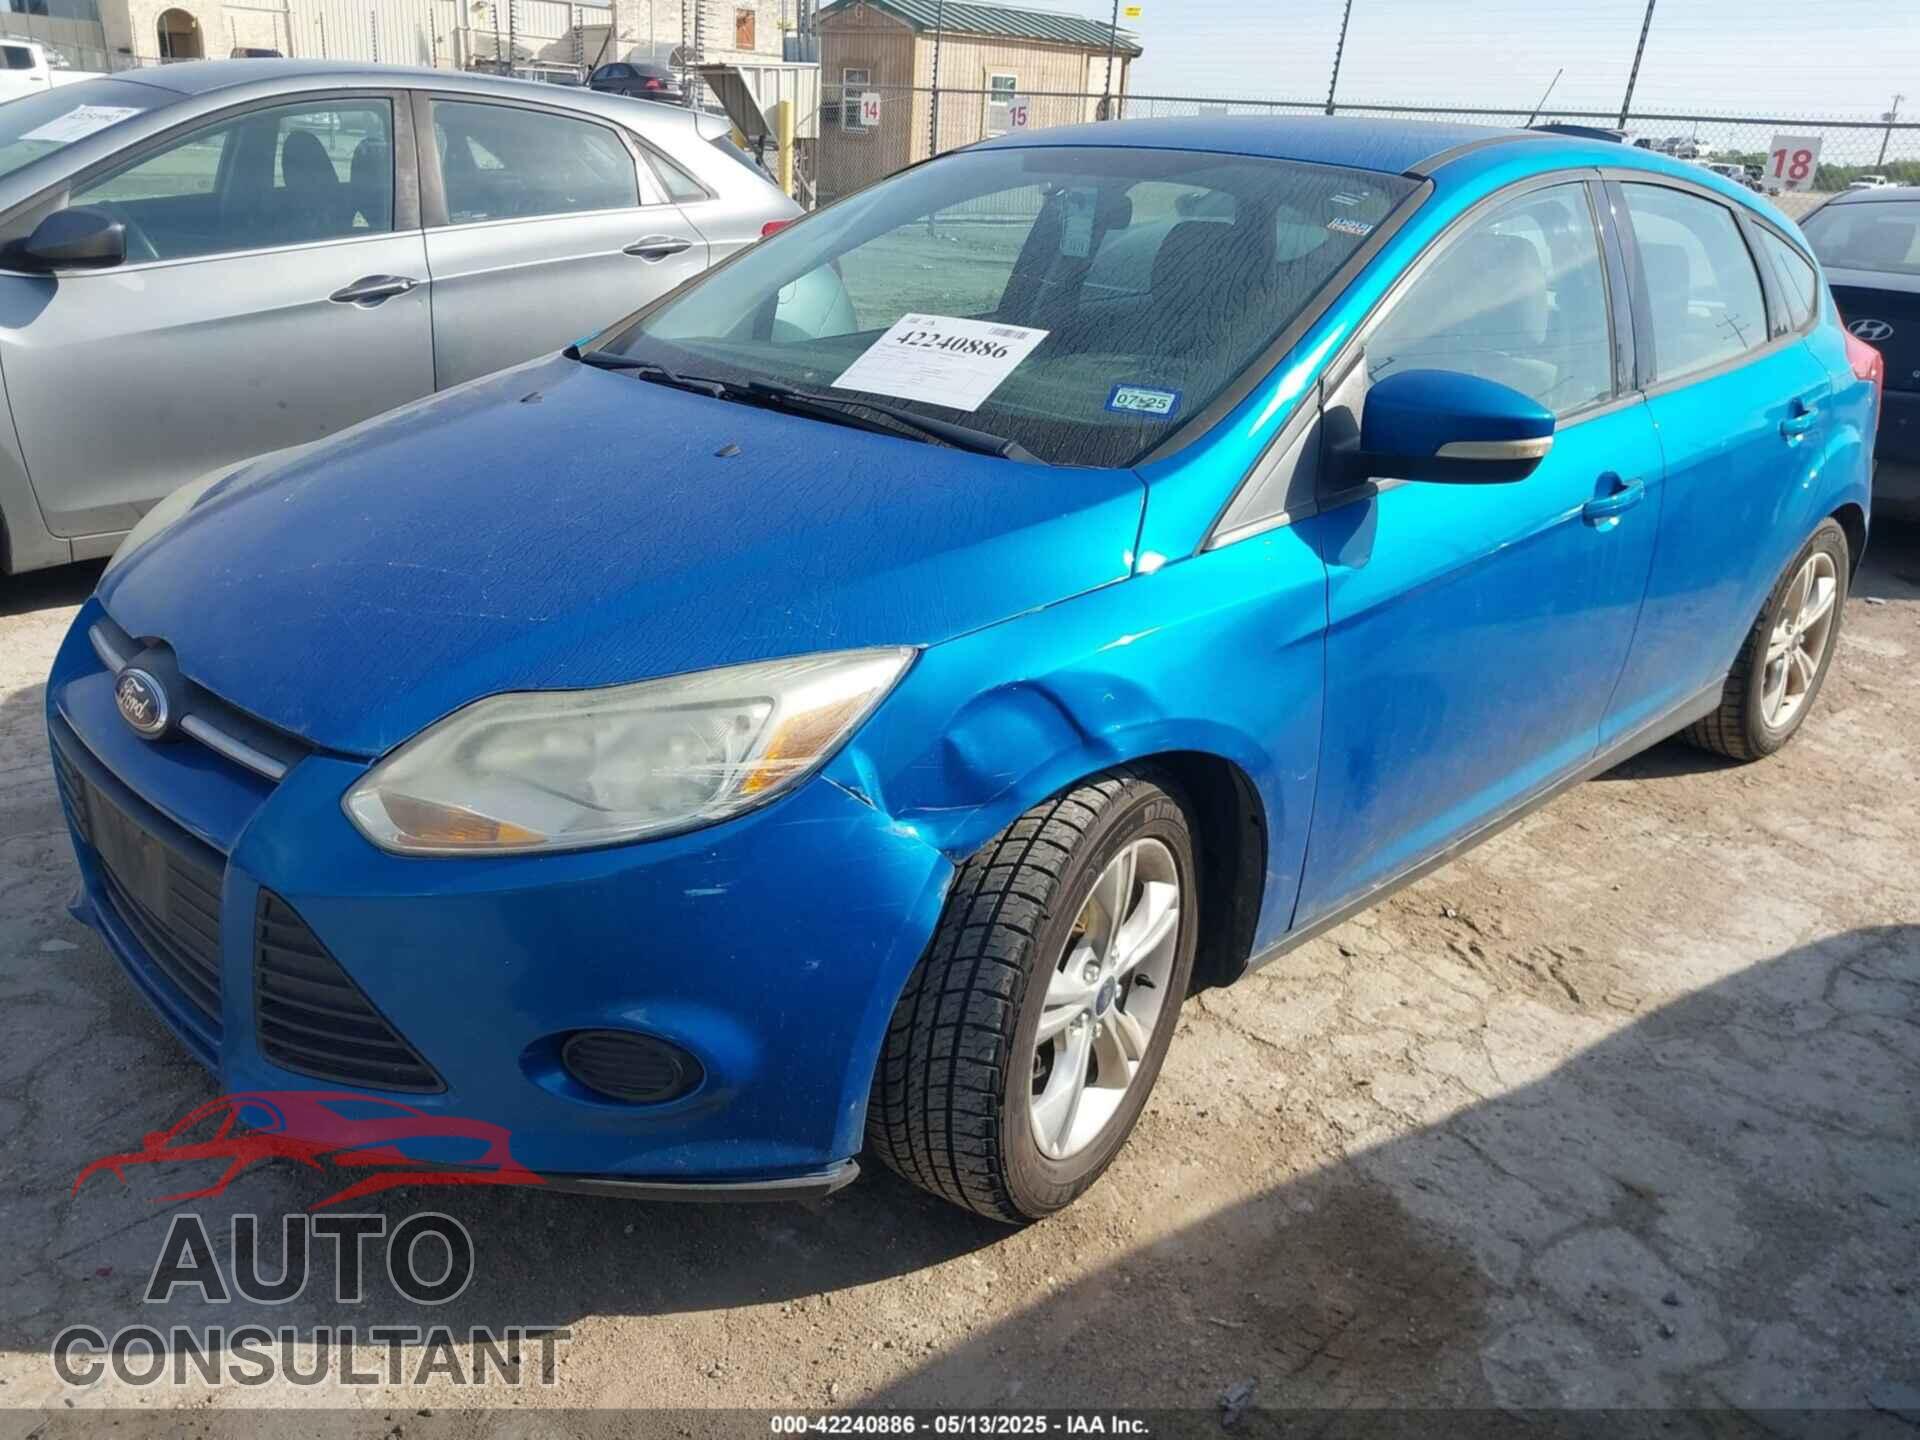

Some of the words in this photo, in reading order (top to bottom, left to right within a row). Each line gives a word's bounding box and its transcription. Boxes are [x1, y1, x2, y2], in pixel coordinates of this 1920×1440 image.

[863, 101, 878, 119] 14
[1009, 105, 1027, 127] 15
[1771, 148, 1813, 181] 18
[896, 330, 1009, 359] 42240886
[1116, 393, 1138, 405] 07
[1144, 397, 1168, 409] 25
[120, 677, 150, 719] Ford
